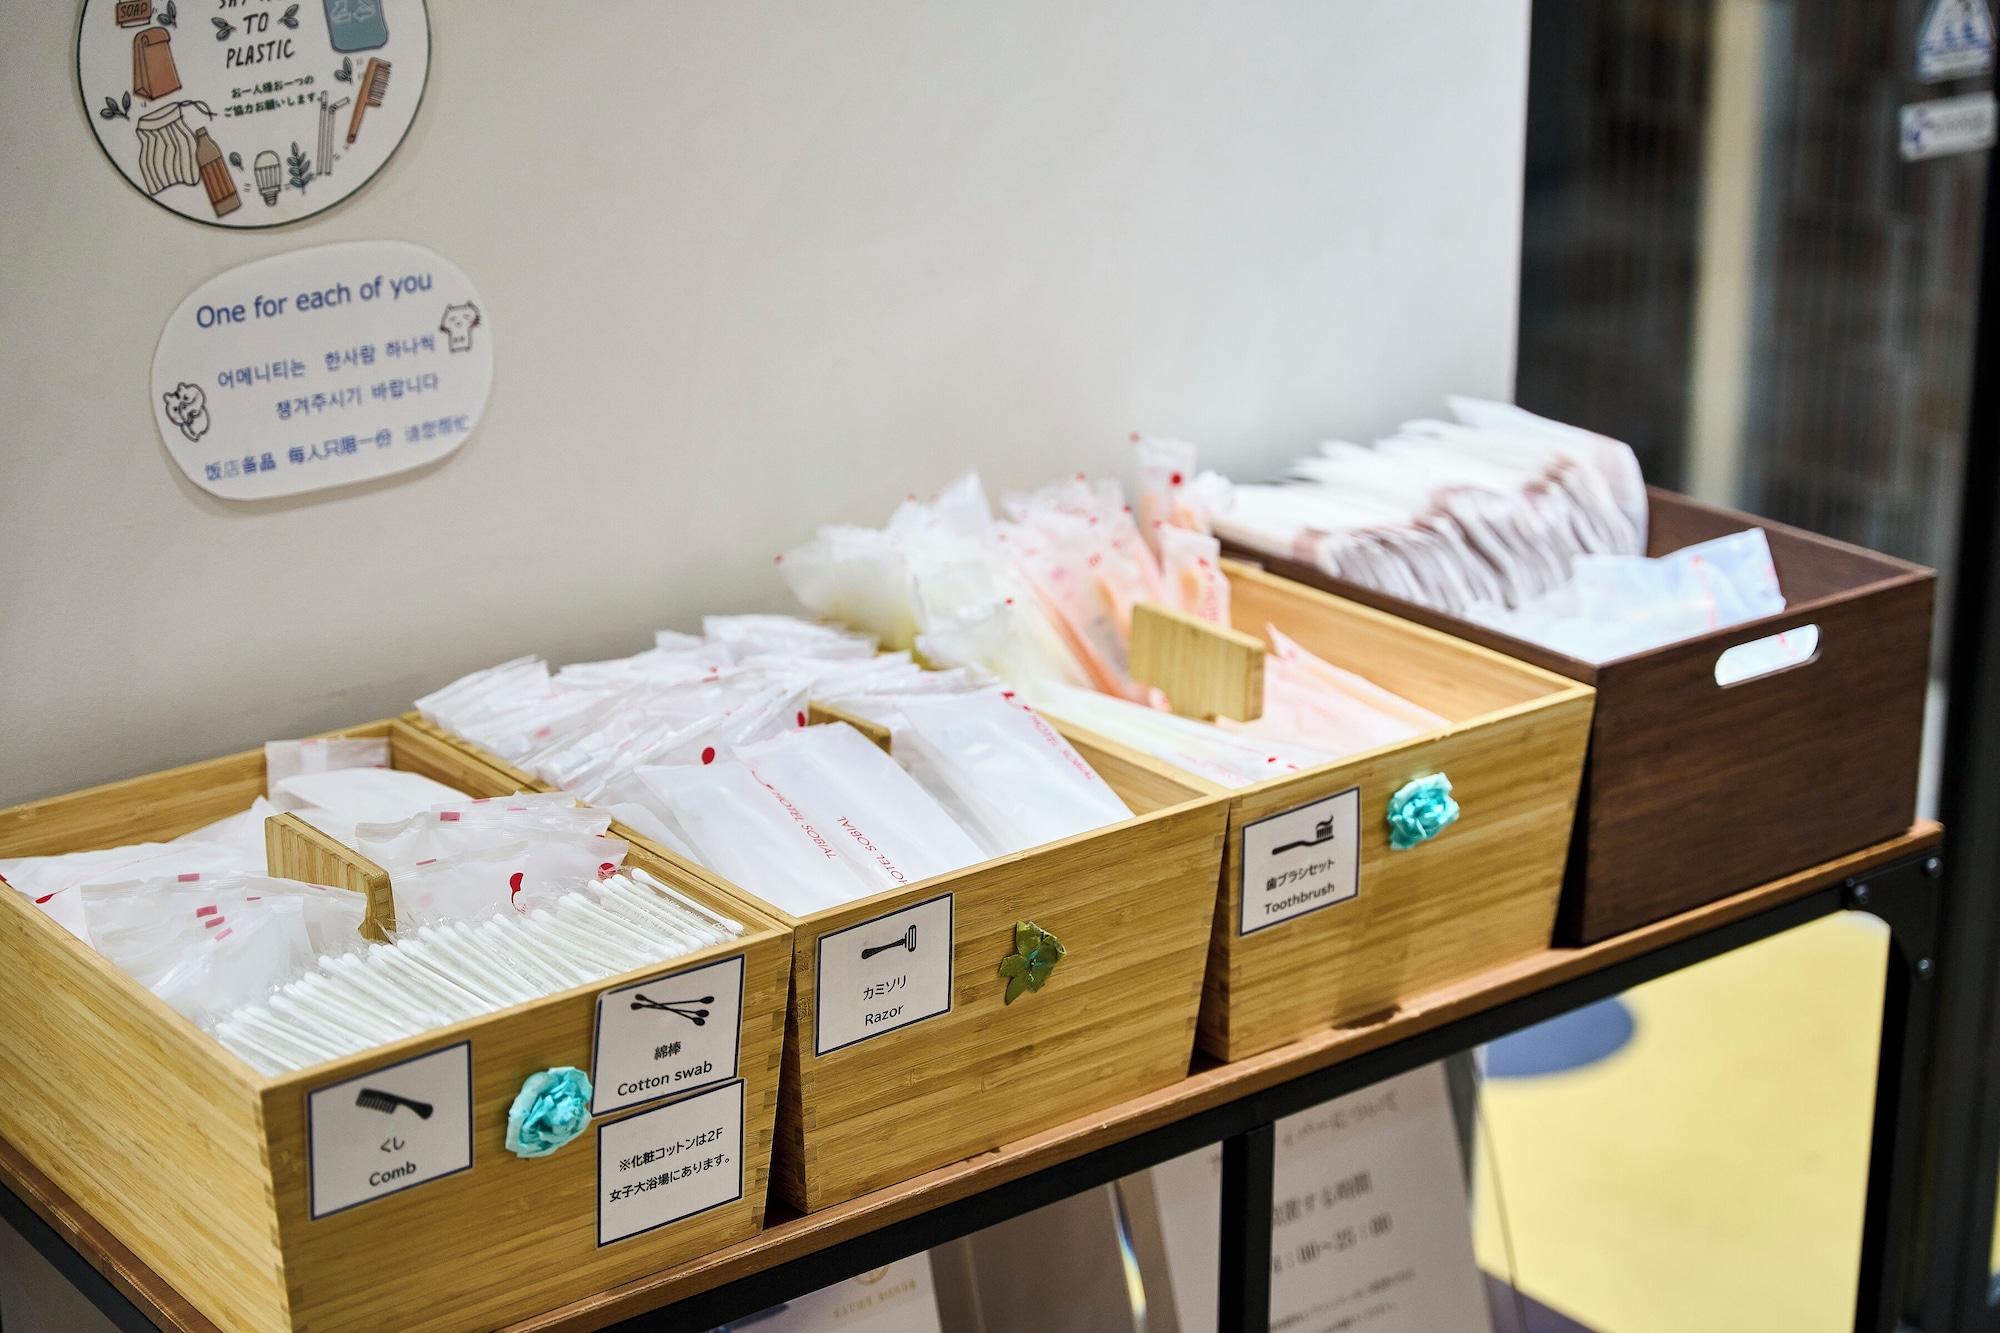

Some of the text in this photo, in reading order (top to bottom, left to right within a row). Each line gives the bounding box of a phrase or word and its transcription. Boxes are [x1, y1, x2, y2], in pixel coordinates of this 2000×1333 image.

[120, 2, 148, 18] SOAP
[242, 12, 269, 34] TO
[226, 38, 295, 68] PLASTIC
[196, 273, 433, 329] One for each of you
[217, 358, 305, 389] 어메니티는
[324, 344, 375, 371] 한사람
[371, 372, 439, 401] 바랍니다
[801, 824, 837, 860] SOBIAL
[837, 815, 877, 852] SOBIAL
[1266, 858, 1335, 891] 歯ブラシセット
[1264, 882, 1335, 914] Toothbrush
[863, 975, 906, 1001] カミソリ
[865, 1004, 904, 1026] Razor
[654, 1040, 682, 1061] 綿棒
[617, 1060, 713, 1097] Cotton swab
[380, 1136, 405, 1153] くし
[369, 1160, 417, 1187] Comb
[609, 1153, 730, 1203] 女子大浴場にあります。
